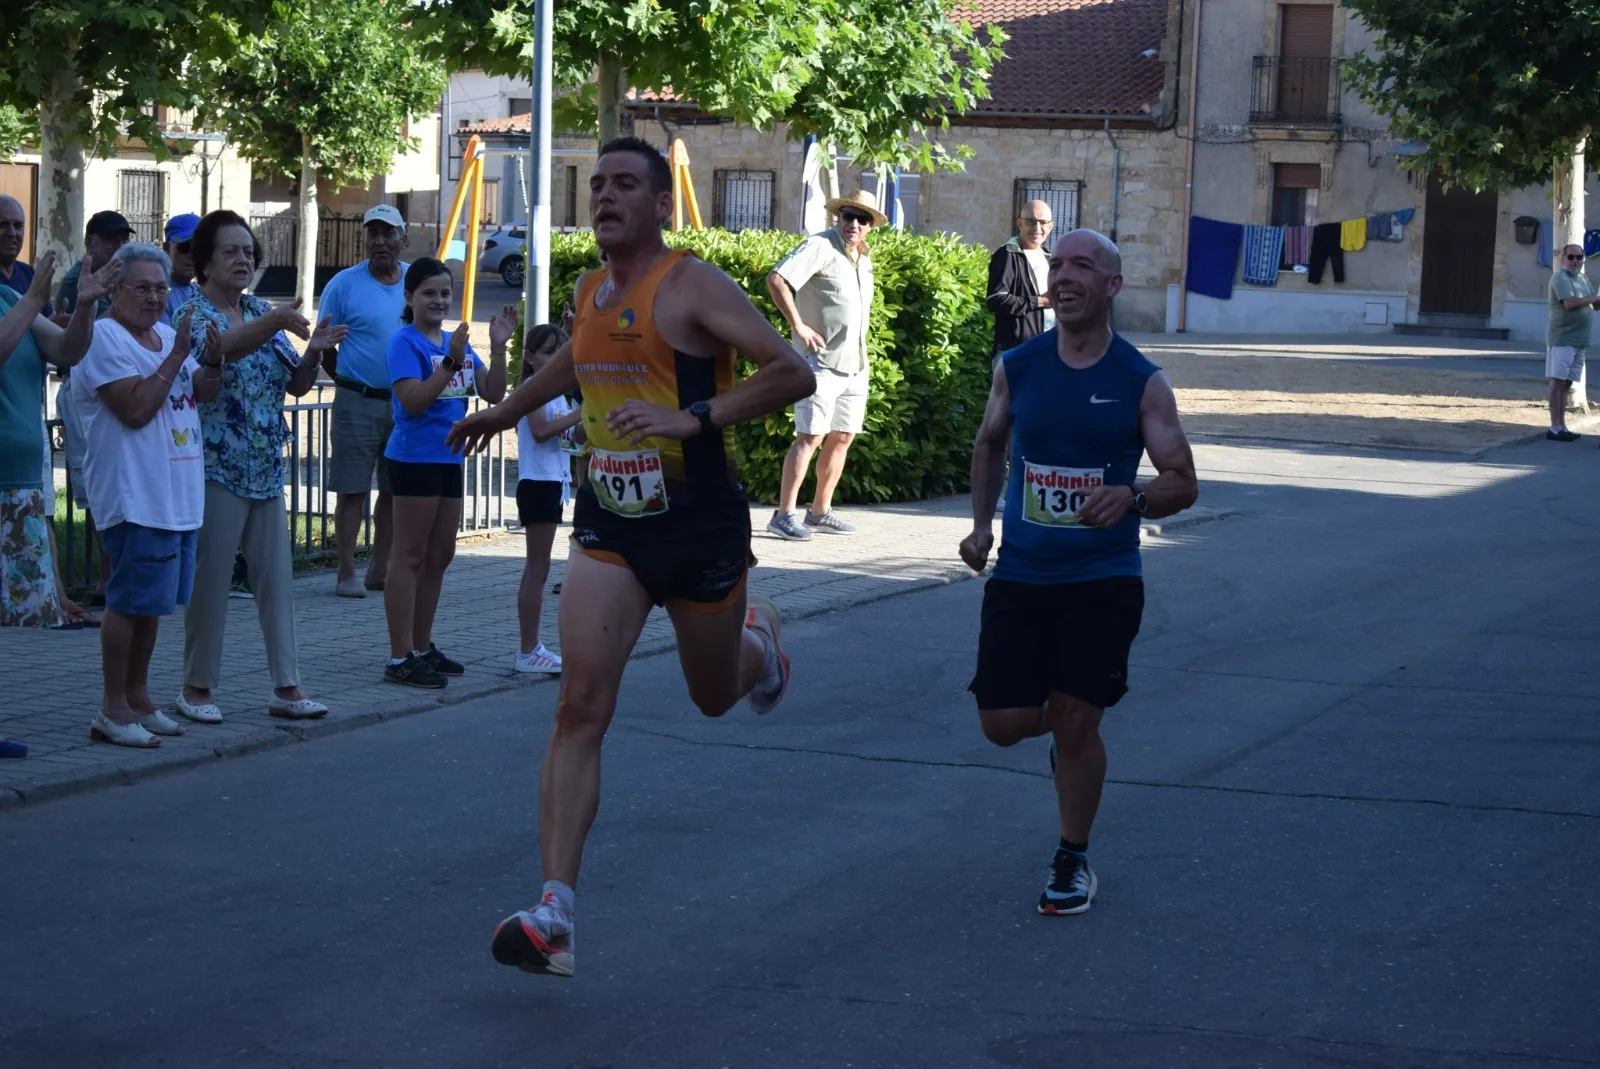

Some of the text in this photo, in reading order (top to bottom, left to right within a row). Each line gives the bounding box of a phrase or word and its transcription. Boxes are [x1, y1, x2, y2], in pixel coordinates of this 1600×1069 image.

[590, 451, 661, 475] bedunia
[600, 474, 644, 501] 191
[1026, 467, 1101, 488] bedunia
[1037, 488, 1086, 513] 130
